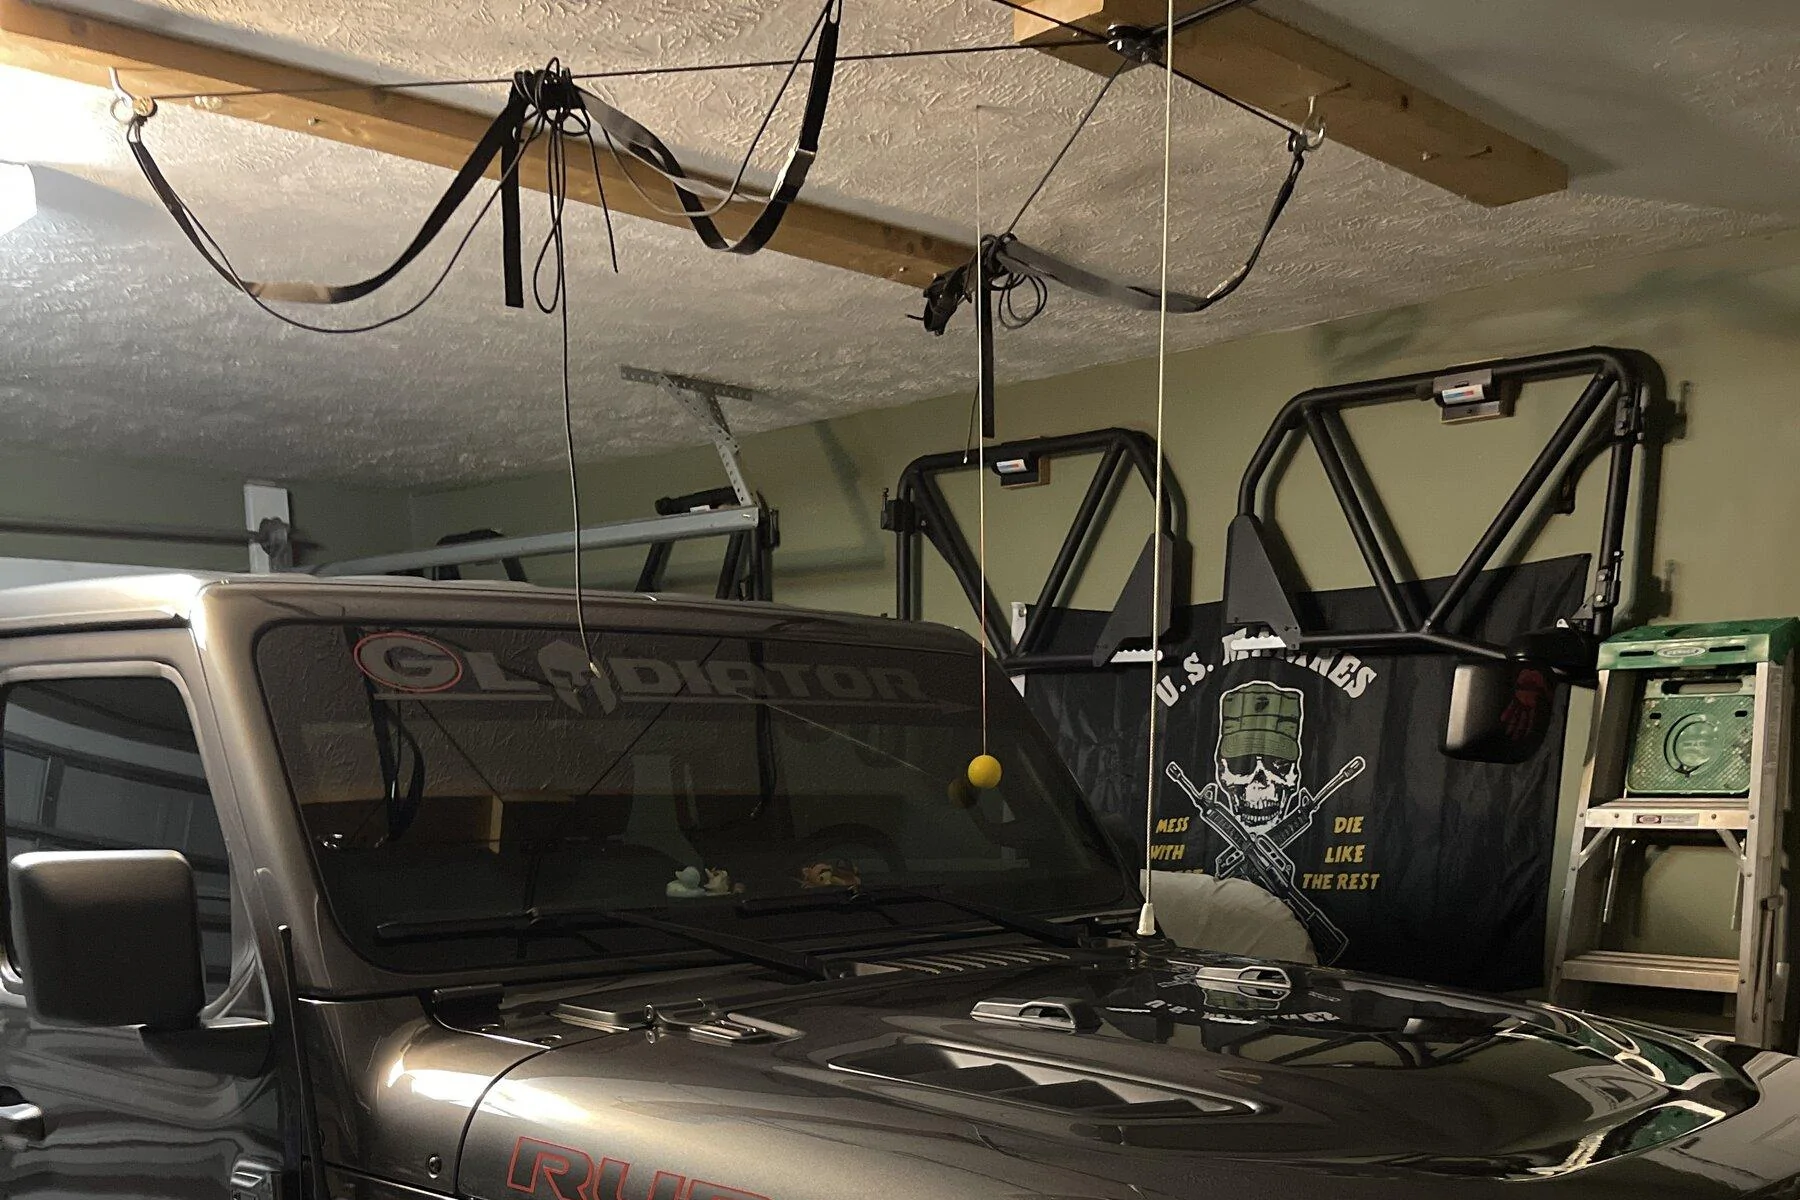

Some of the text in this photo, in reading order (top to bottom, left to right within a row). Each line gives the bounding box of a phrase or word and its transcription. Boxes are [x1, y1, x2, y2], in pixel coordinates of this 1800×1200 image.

[1155, 627, 1377, 707] U.S. MNES
[1155, 816, 1190, 833] MESS
[1333, 815, 1364, 834] DIE
[1150, 844, 1186, 860] WITH
[1324, 844, 1366, 863] LIKE
[1302, 873, 1380, 890] THE REST
